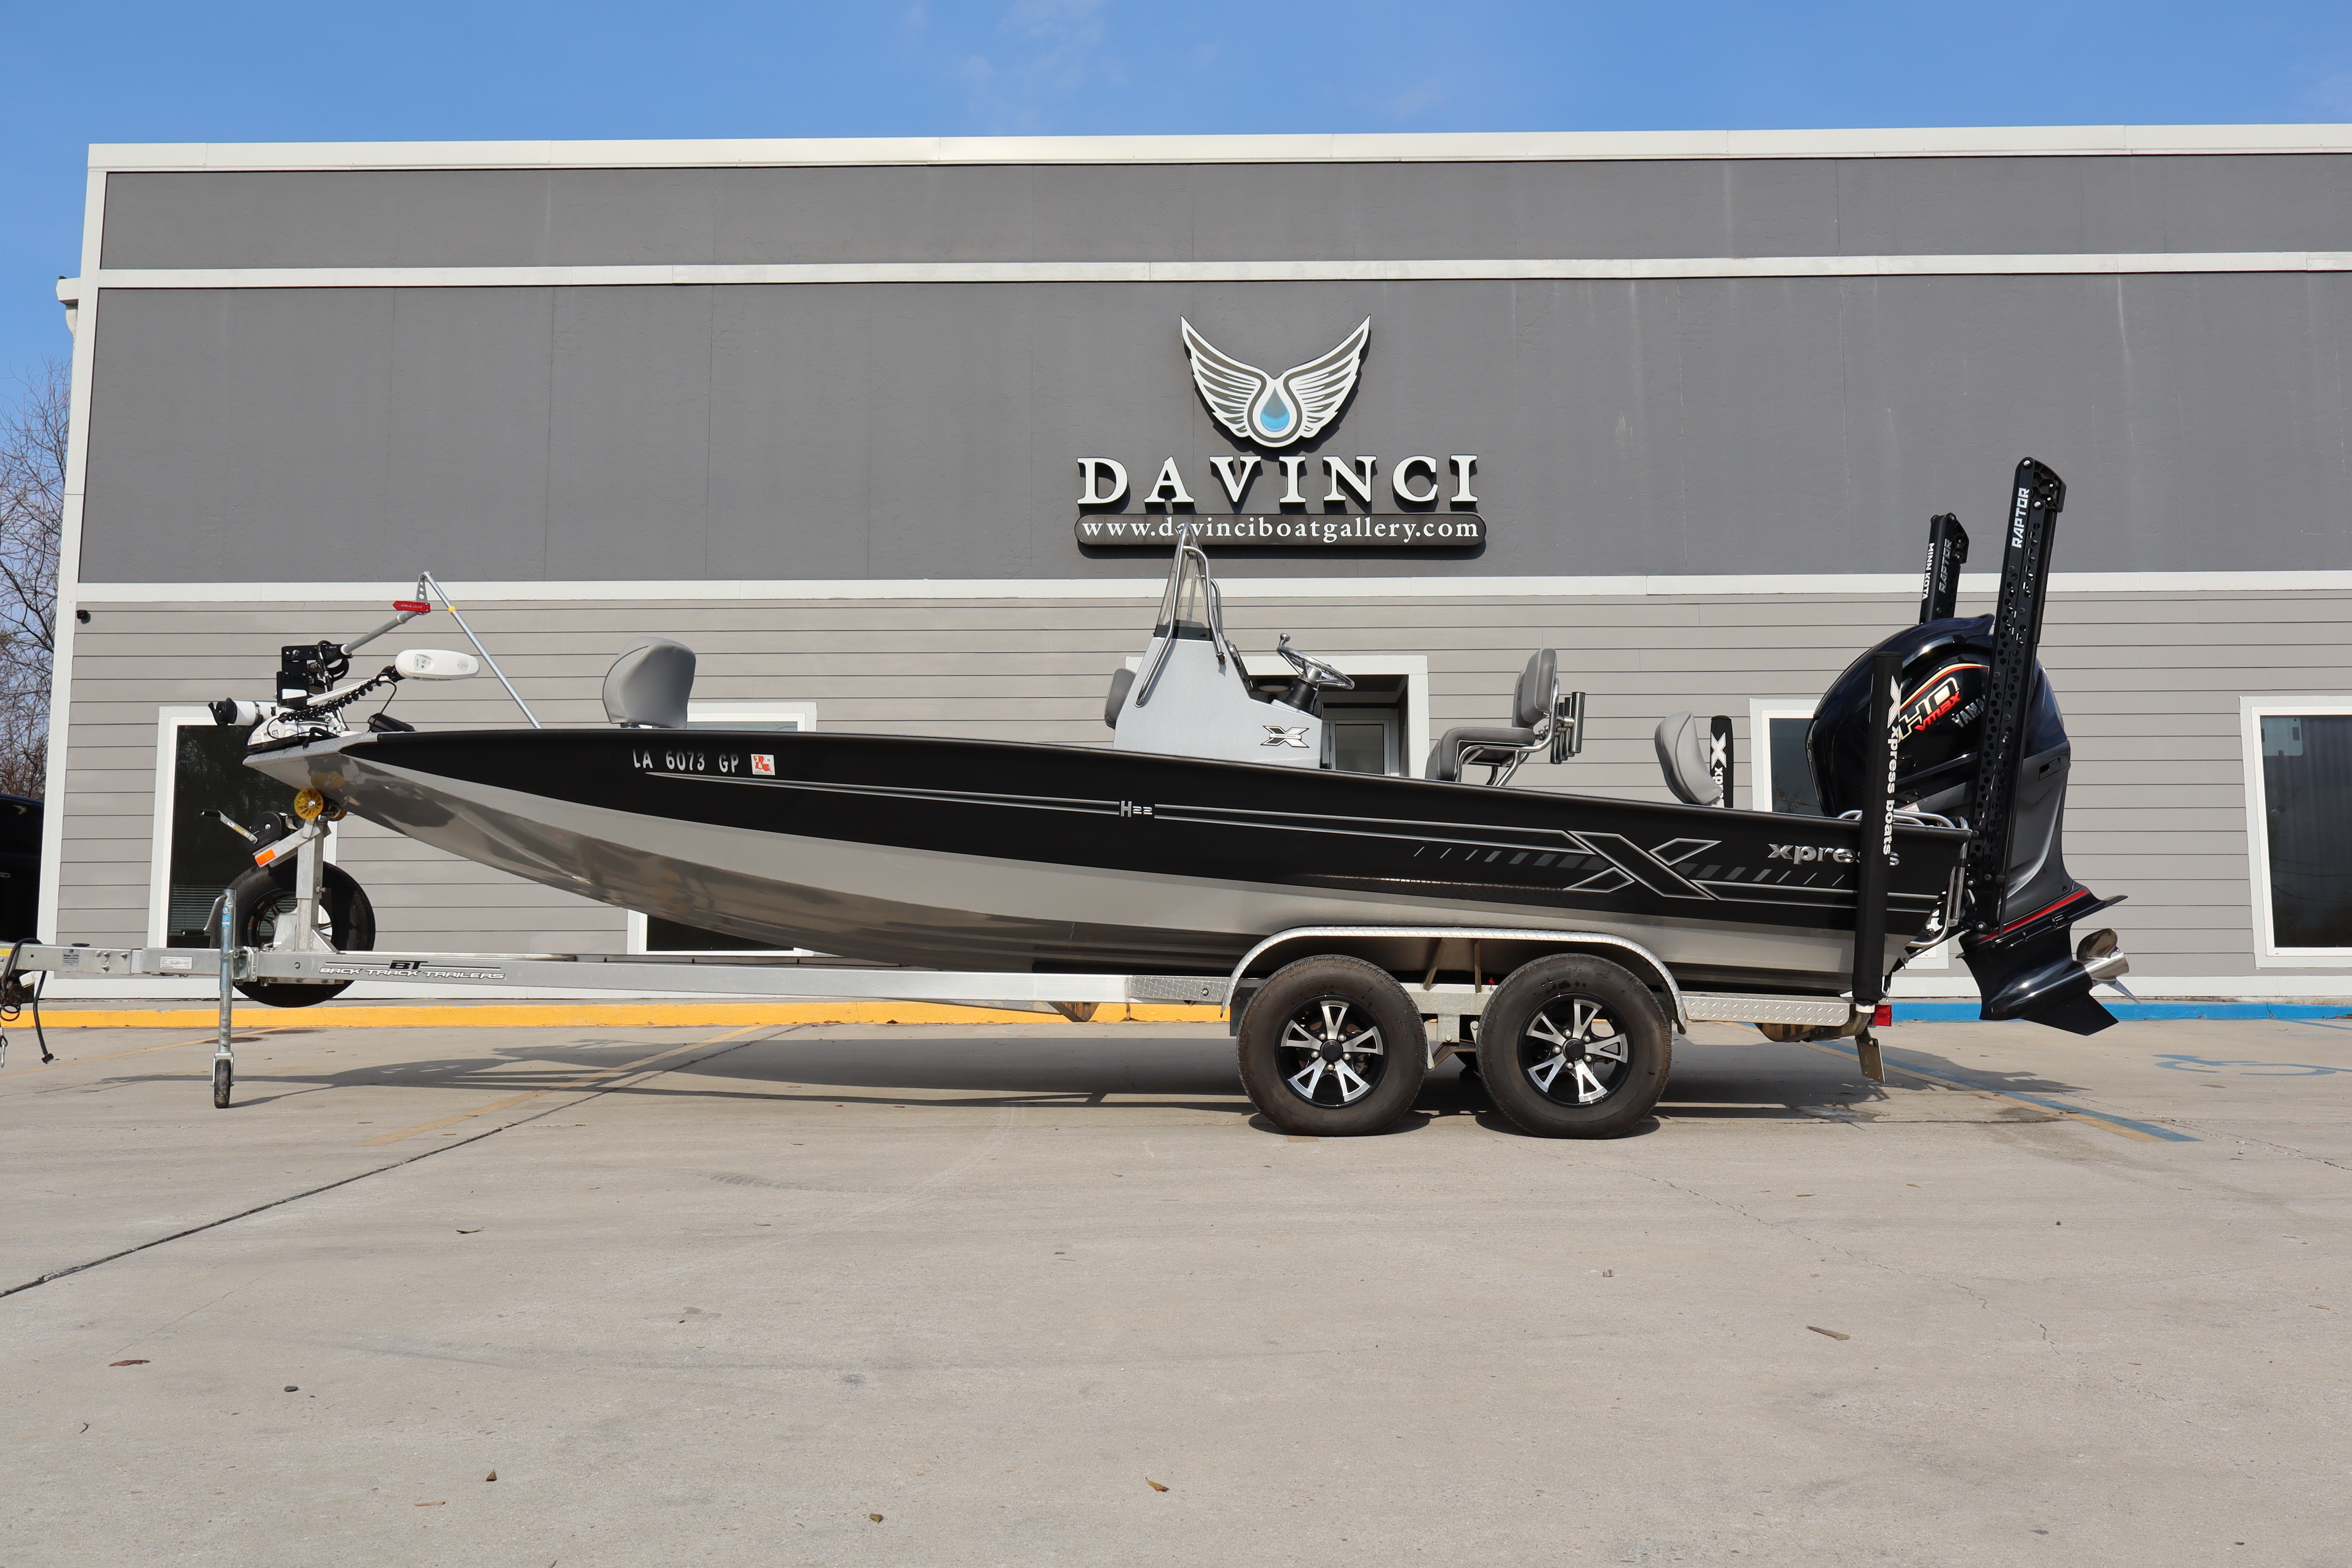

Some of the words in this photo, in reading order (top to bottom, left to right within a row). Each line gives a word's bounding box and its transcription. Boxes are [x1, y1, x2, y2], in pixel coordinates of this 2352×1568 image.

[1077, 455, 1478, 505] DAVINCI
[2011, 487, 2029, 548] RAPTOR
[1926, 543, 1935, 571] MINN
[1939, 538, 1952, 593] RAPTOR
[1922, 572, 1931, 600] KOTA
[1898, 677, 1960, 743] HO
[1951, 694, 1985, 728] YAMA
[633, 749, 653, 768] LA
[666, 751, 705, 771] 6073
[719, 753, 739, 773] GP
[1887, 726, 1898, 793] xpress
[1121, 800, 1152, 817] H22
[1883, 799, 1895, 855] boats
[1767, 844, 1900, 866] xpre
[390, 960, 428, 970] BT
[424, 971, 506, 979] TRAILERS
